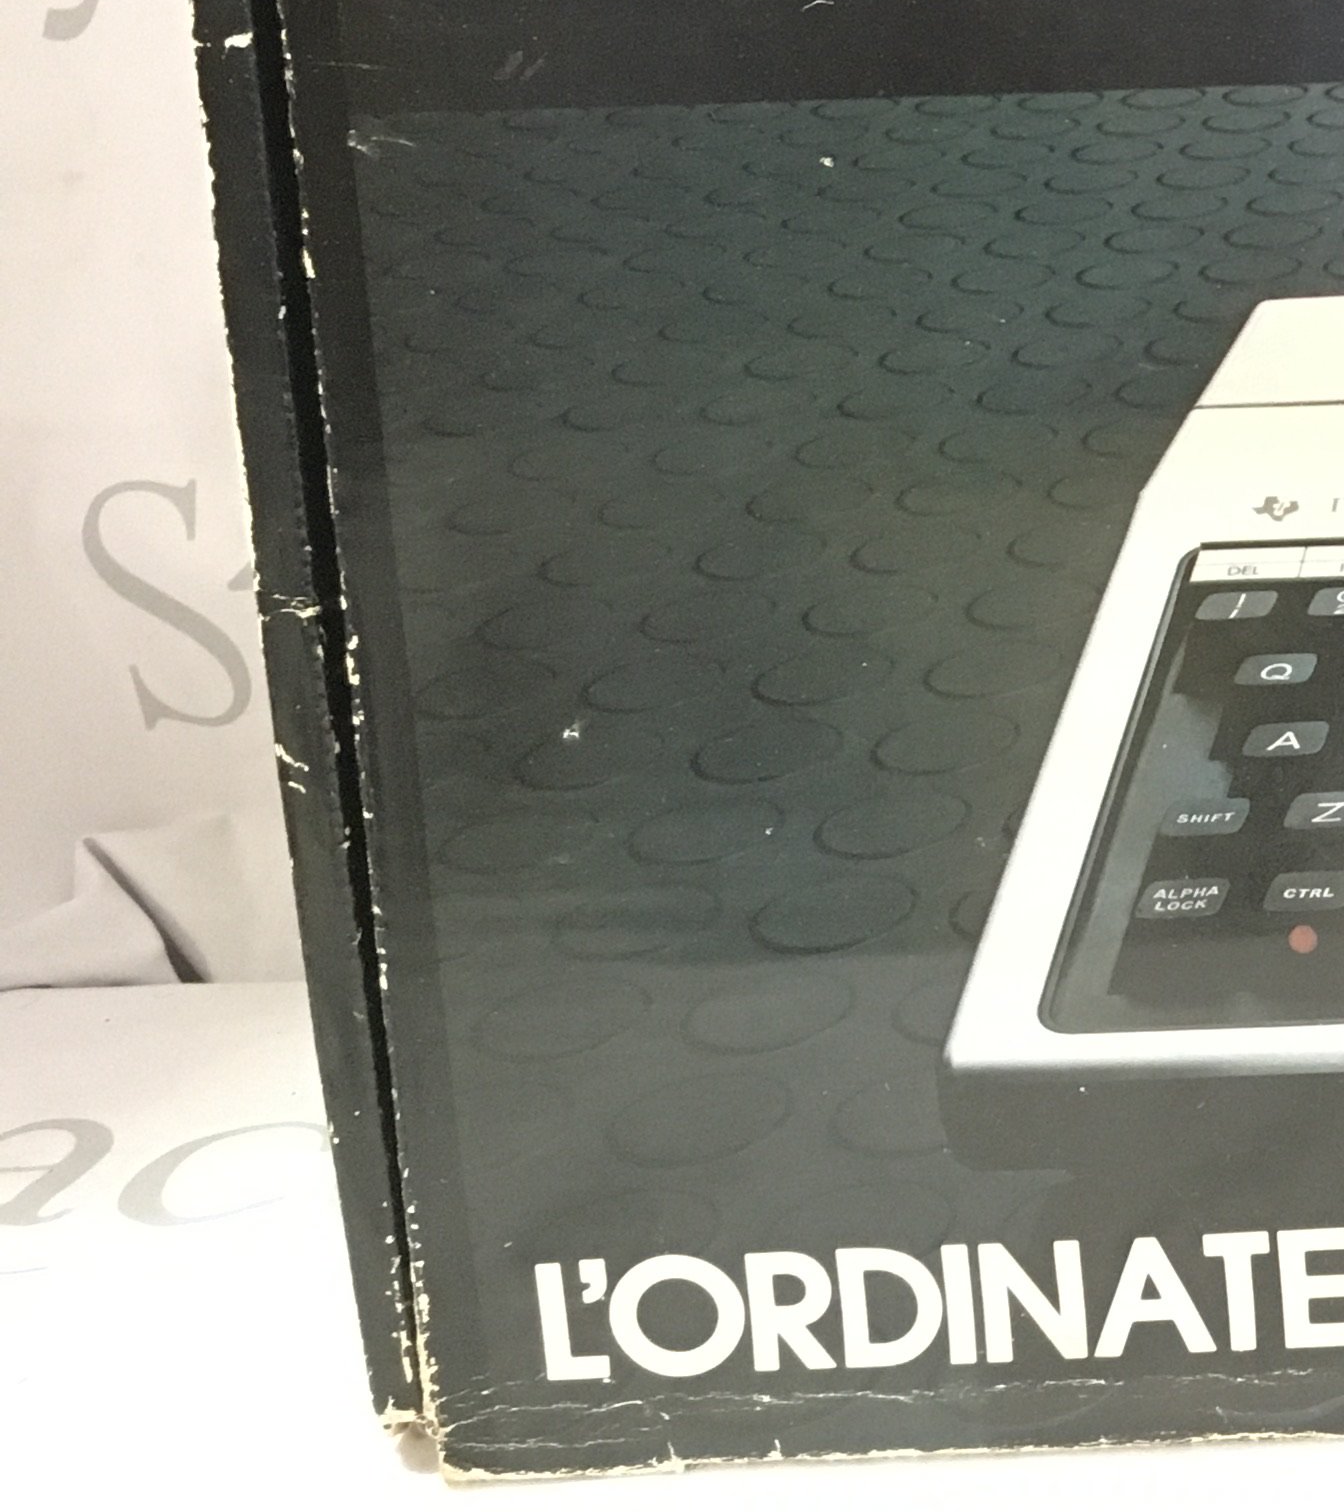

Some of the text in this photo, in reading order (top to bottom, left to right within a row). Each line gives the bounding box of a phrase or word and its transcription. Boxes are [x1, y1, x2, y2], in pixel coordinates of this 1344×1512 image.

[1226, 565, 1259, 577] DEL
[1260, 663, 1293, 681] Q
[1266, 731, 1301, 751] A
[1176, 811, 1236, 825] SHIFT
[1153, 885, 1220, 899] ALPHA
[1283, 887, 1336, 899] CTRL
[1153, 899, 1209, 912] LOCK
